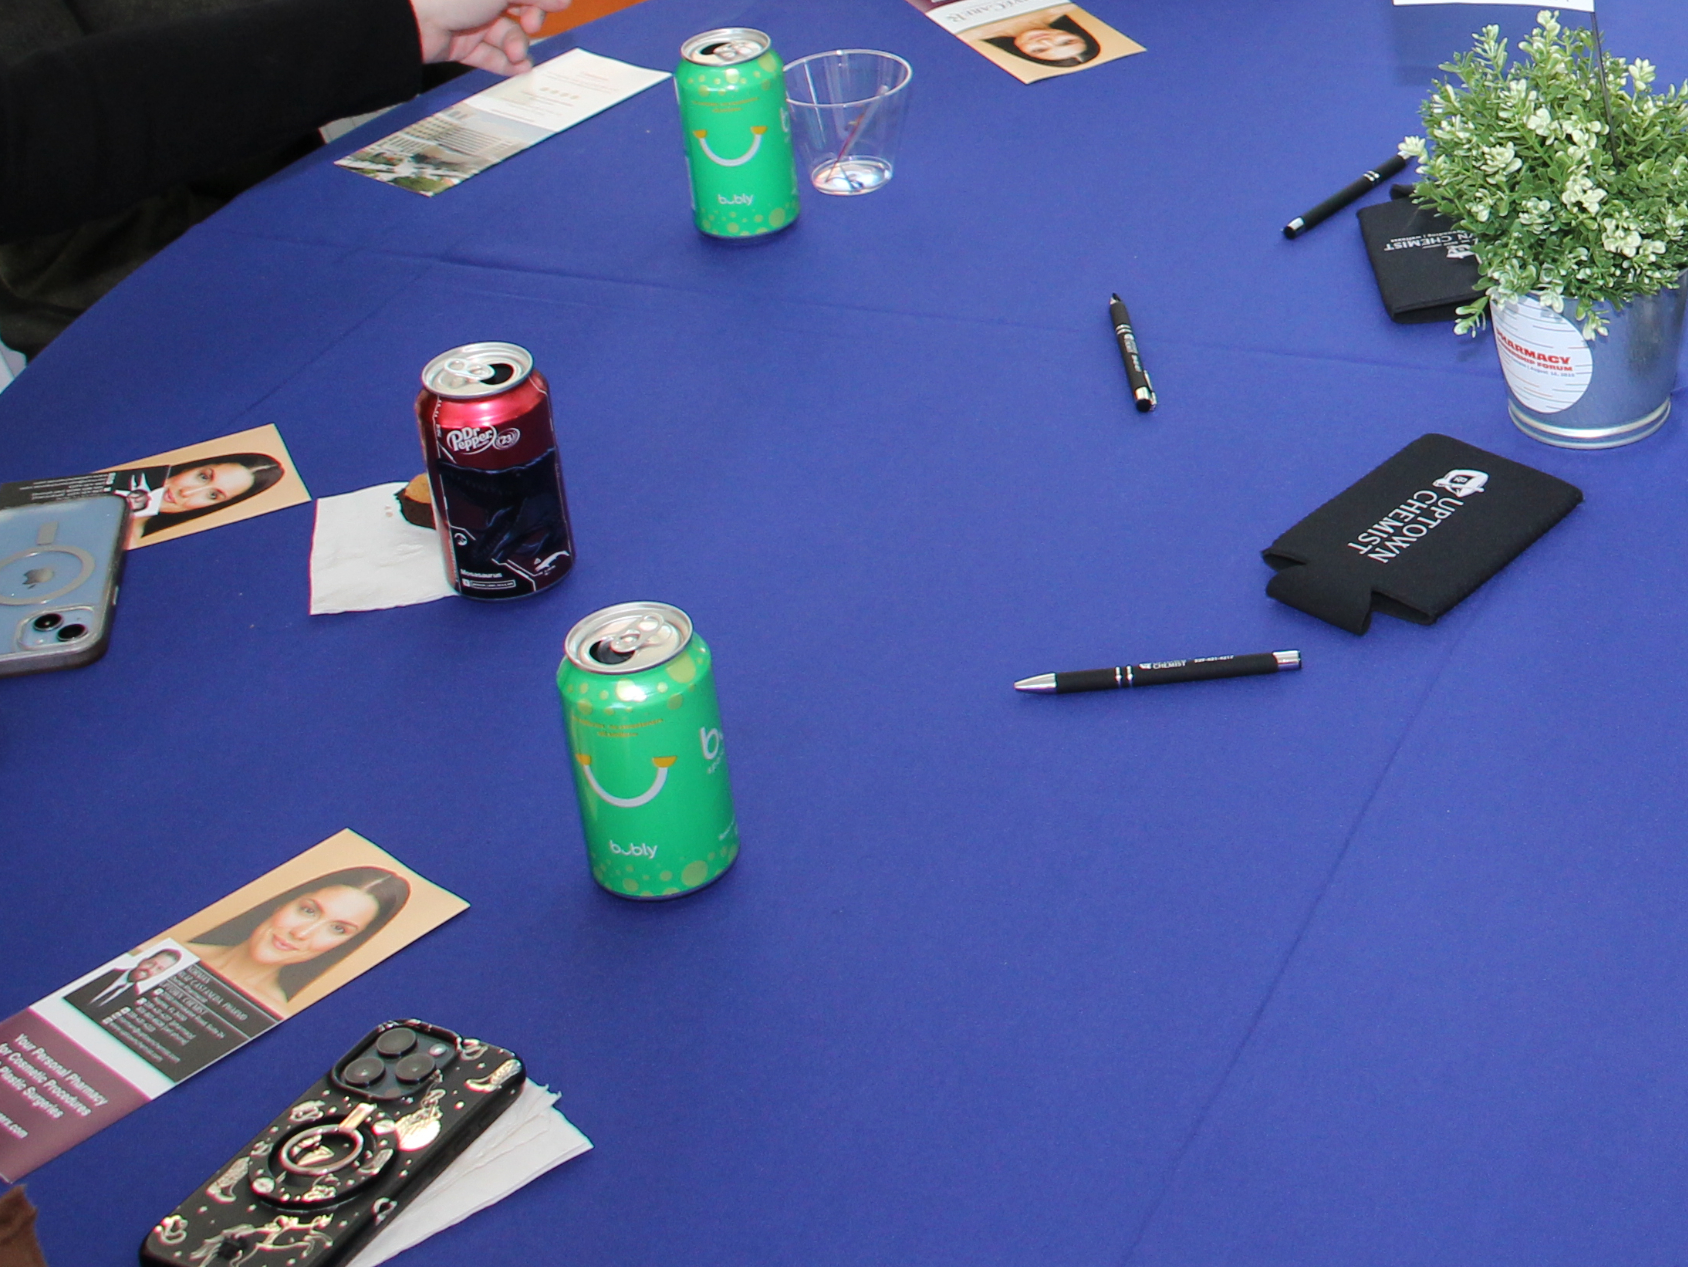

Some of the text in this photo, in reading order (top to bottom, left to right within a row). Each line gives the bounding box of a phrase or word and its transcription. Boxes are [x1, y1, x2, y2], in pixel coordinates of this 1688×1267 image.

[1383, 236, 1452, 251] CHEMIST
[447, 429, 493, 451] Pepper
[462, 427, 480, 440] Dr
[1347, 490, 1438, 555] CHEMIST
[1367, 498, 1464, 564] UPTOWN
[609, 839, 658, 859] bubly
[8, 1052, 48, 1084] Cosmetic
[42, 1079, 92, 1117] Procedures
[31, 1047, 72, 1078] Personal
[65, 1073, 108, 1107] Pharmacy
[22, 1086, 64, 1119] Surgeries
